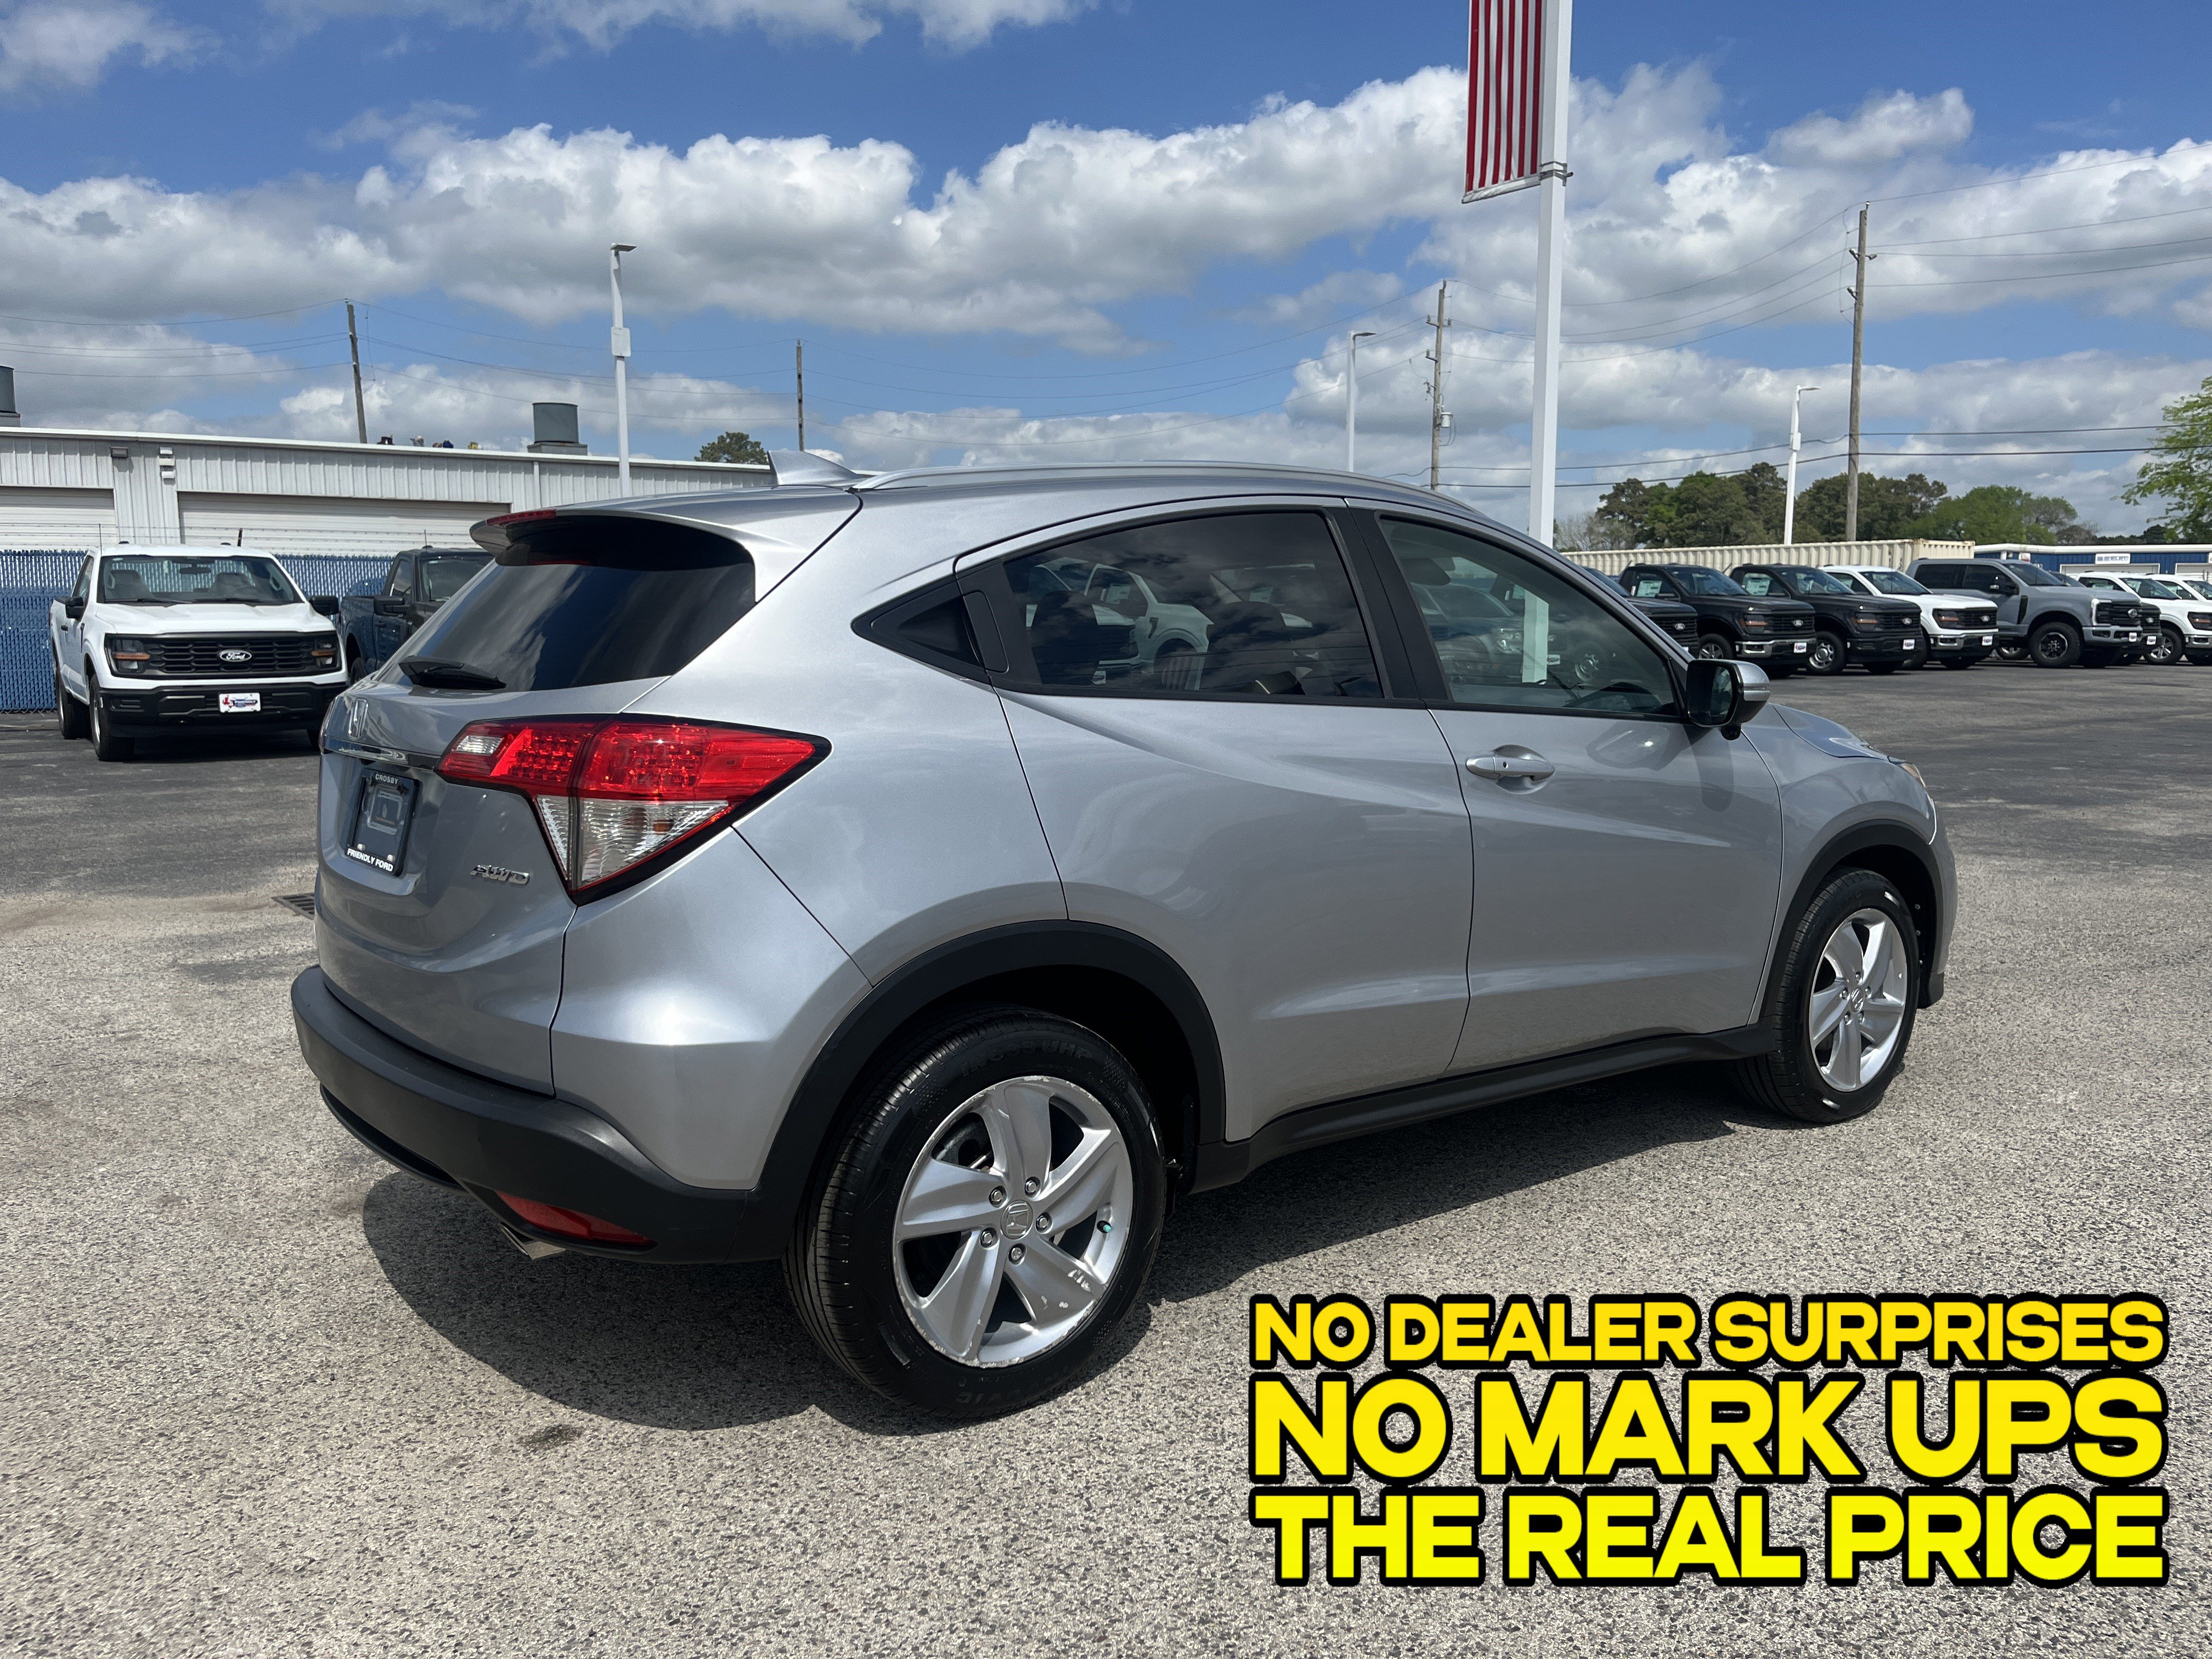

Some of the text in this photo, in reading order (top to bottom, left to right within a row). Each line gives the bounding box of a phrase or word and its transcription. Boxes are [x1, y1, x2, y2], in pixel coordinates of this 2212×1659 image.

[375, 774, 399, 785] CROSBY
[347, 848, 393, 872] FRIENDLY FORD
[470, 865, 529, 884] AWD
